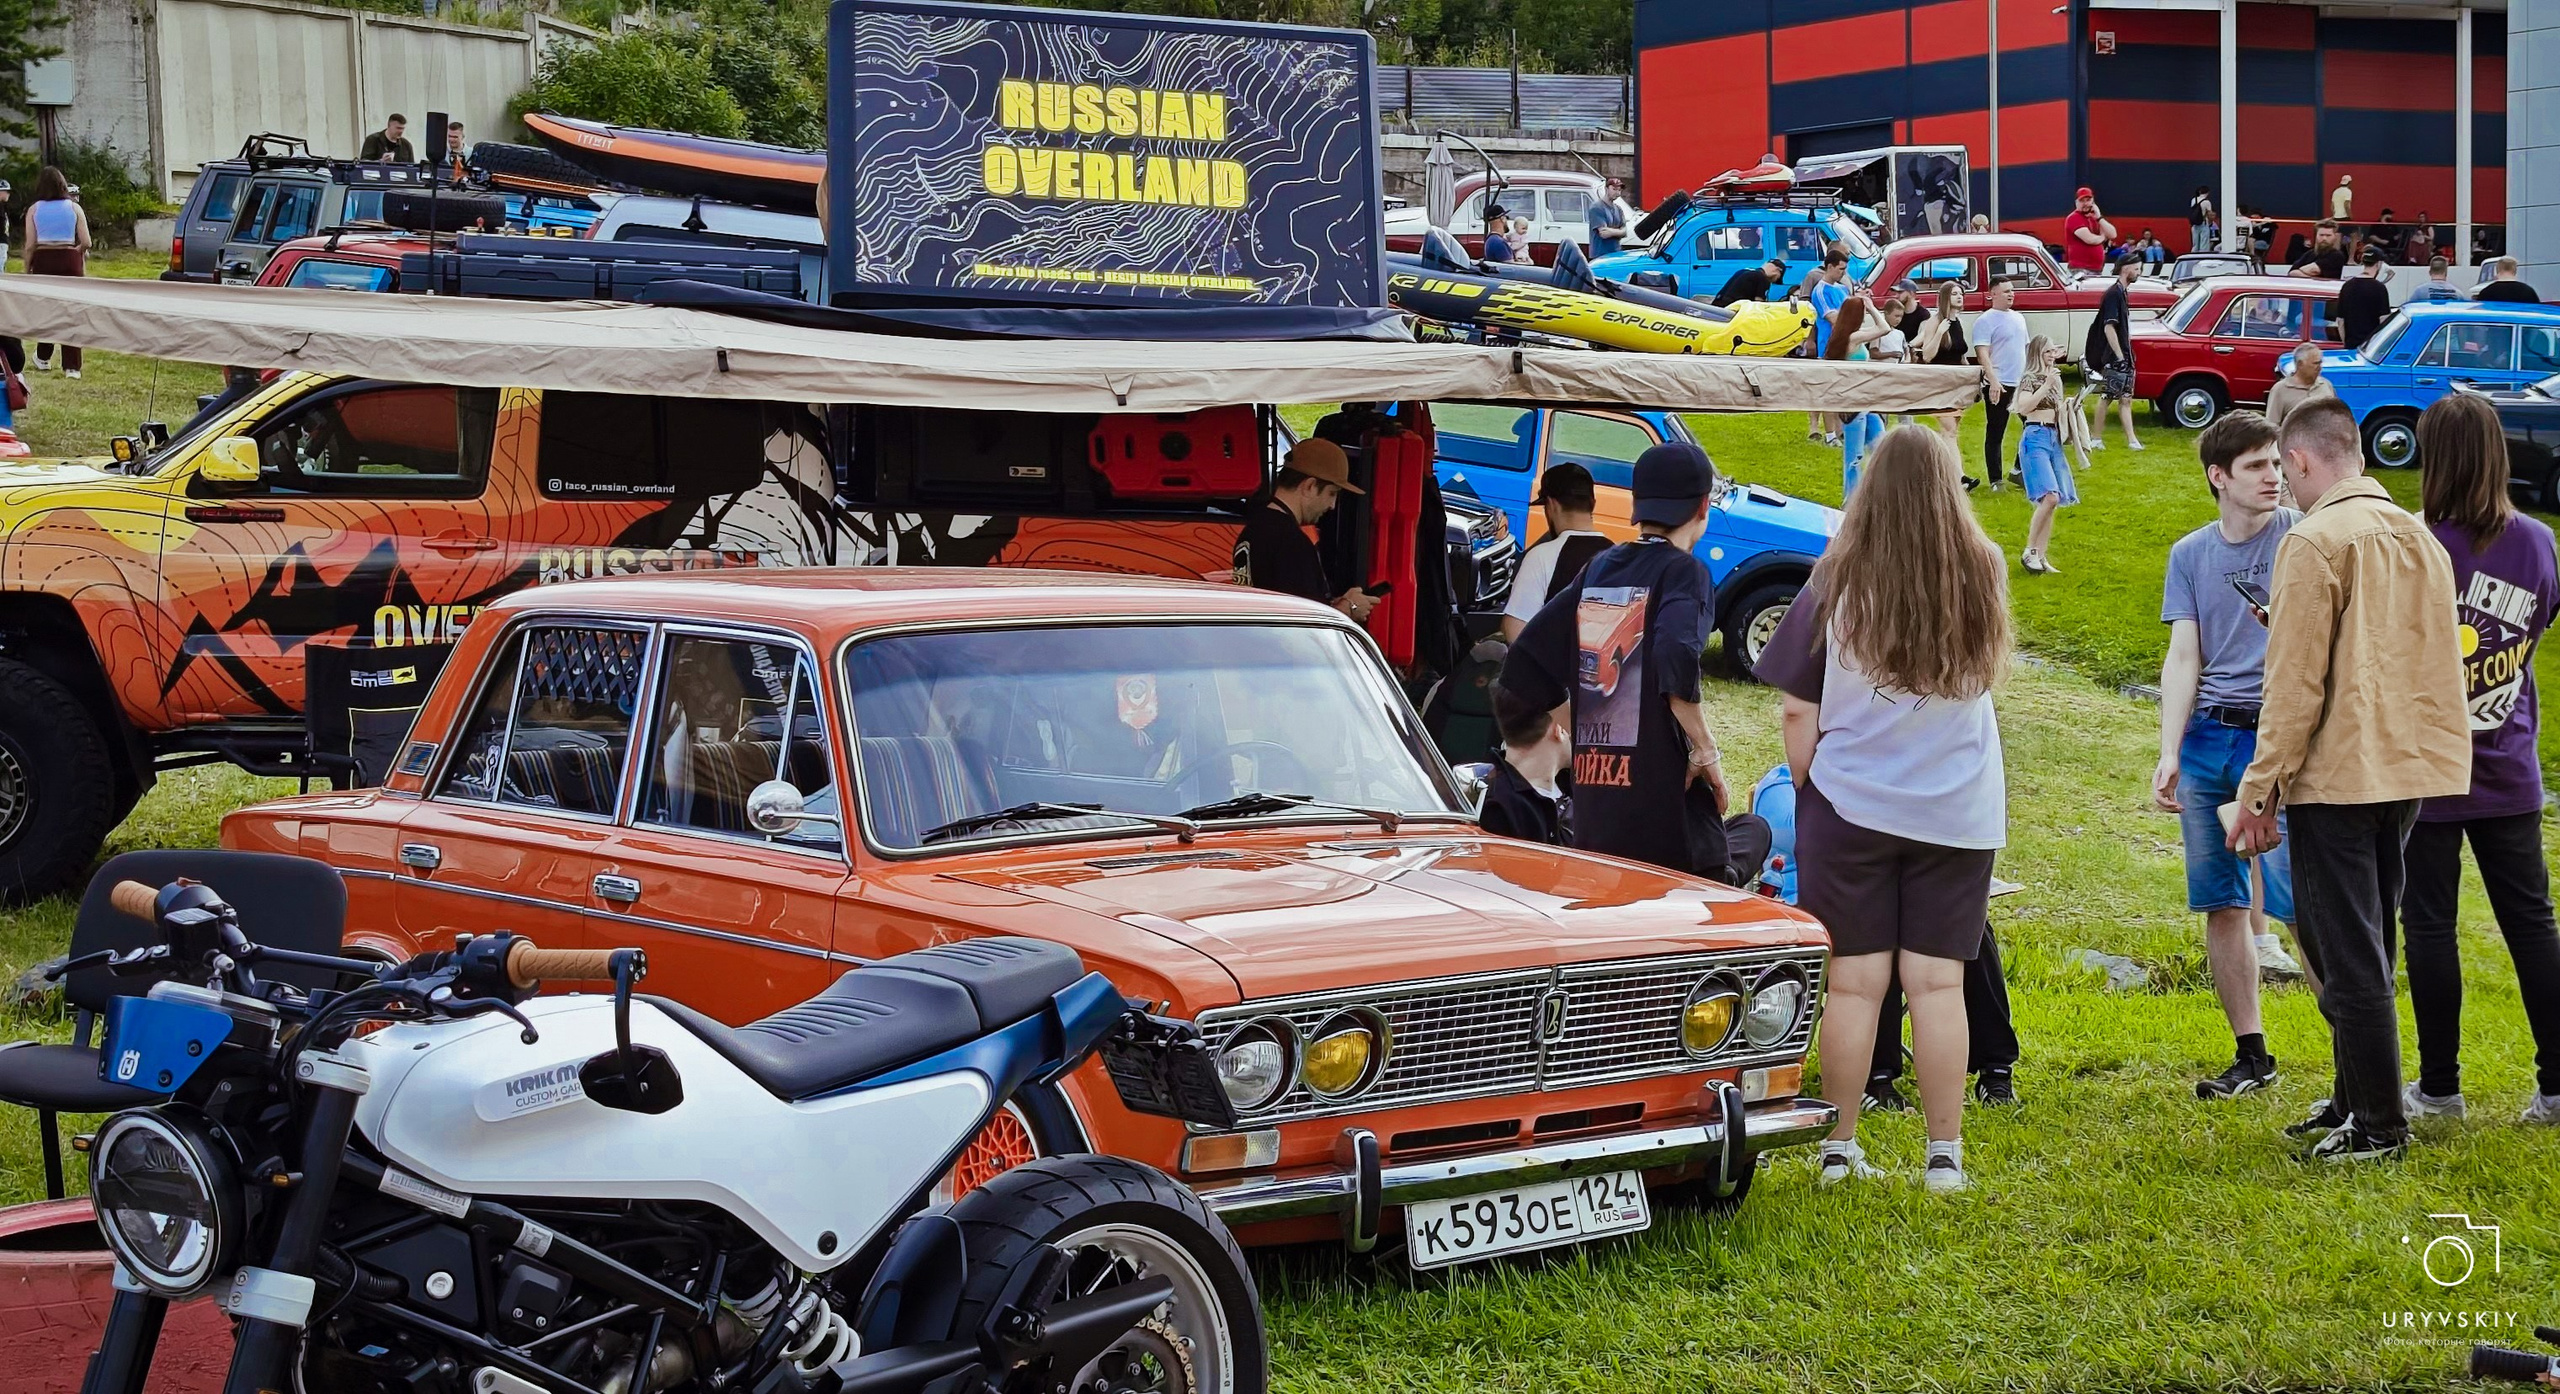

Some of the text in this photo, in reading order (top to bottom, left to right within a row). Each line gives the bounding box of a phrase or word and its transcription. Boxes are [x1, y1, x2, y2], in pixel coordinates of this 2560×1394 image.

[1002, 80, 1225, 141] RUSSIAN
[984, 146, 1246, 208] OVERLAND
[1140, 273, 1187, 287] RUSSIAN
[1388, 273, 1418, 288] K2
[1603, 311, 1699, 340] EXPLORER
[565, 482, 675, 494] taco_russian_overland
[374, 605, 484, 648] OVE
[1574, 747, 1631, 787] ОЙКА
[506, 1070, 554, 1097] KRIK
[515, 1089, 558, 1108] CUSTOM
[1578, 1172, 1632, 1213] 124
[1594, 1208, 1621, 1225] RUS
